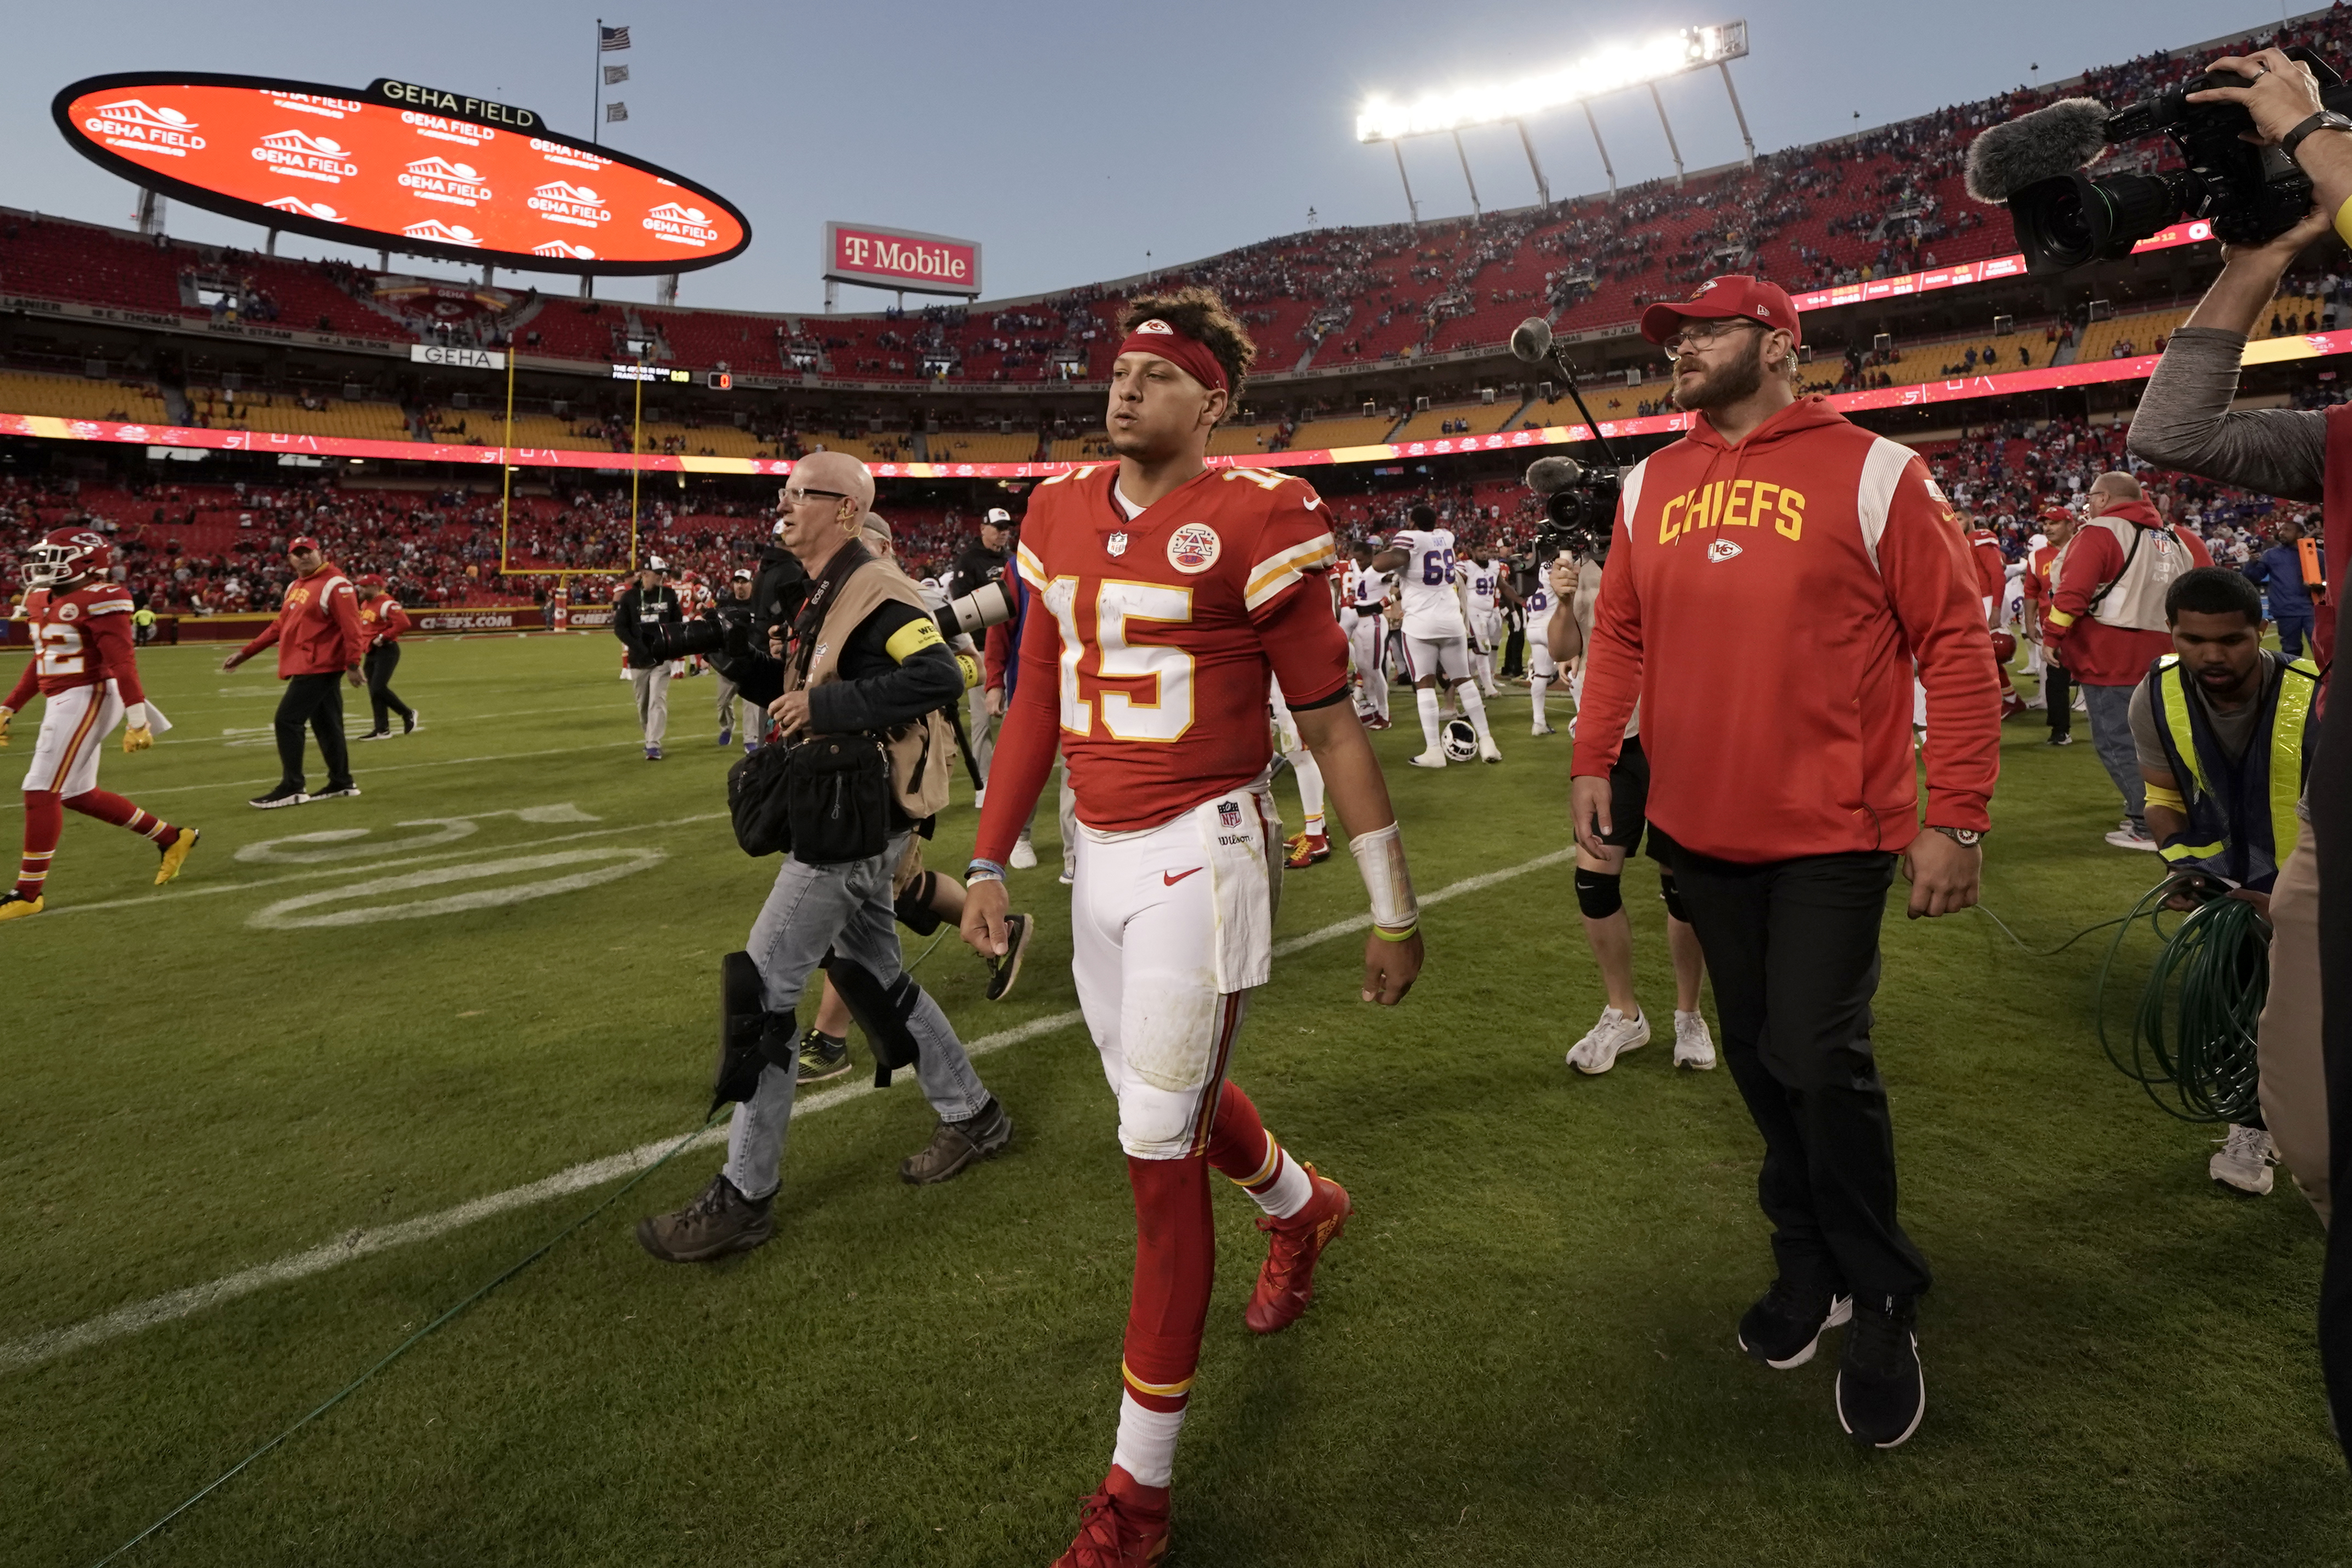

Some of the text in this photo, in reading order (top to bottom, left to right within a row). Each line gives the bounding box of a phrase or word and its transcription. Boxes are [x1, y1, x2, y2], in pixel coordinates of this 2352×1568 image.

[383, 81, 534, 127] GEHA FIELD
[401, 111, 448, 131] GEHA
[451, 121, 495, 140] FIELD
[2109, 112, 2125, 121] SONY
[85, 117, 146, 140] GEHA
[149, 128, 206, 150] FIELD
[530, 138, 572, 157] GEHA
[251, 147, 305, 167] GEHA
[307, 157, 359, 176] FIELD
[398, 173, 445, 192] GEHA
[447, 182, 492, 200] FIELD
[527, 197, 570, 215] GEHA
[572, 205, 612, 222] FIELD
[642, 218, 681, 234] GEHA
[682, 225, 718, 241] FIELD
[2161, 232, 2176, 242] 12
[845, 237, 966, 278] T Mobile
[438, 289, 466, 300] GEHA
[1621, 326, 1637, 334] ALT
[425, 346, 491, 367] GEHA
[612, 372, 656, 382] FRANCSCO.
[1659, 479, 1806, 545] CHIEFS
[1111, 542, 1123, 552] NFL
[1431, 536, 1446, 547] HART
[1715, 544, 1734, 556] KC
[1423, 549, 1455, 585] 68
[1357, 580, 1367, 600] 4
[1476, 576, 1494, 595] 91
[675, 589, 692, 608] 73
[811, 588, 825, 605] EOS
[1041, 574, 1195, 743] 15
[1221, 812, 1241, 826] NFL
[1218, 835, 1251, 846] Wilson
